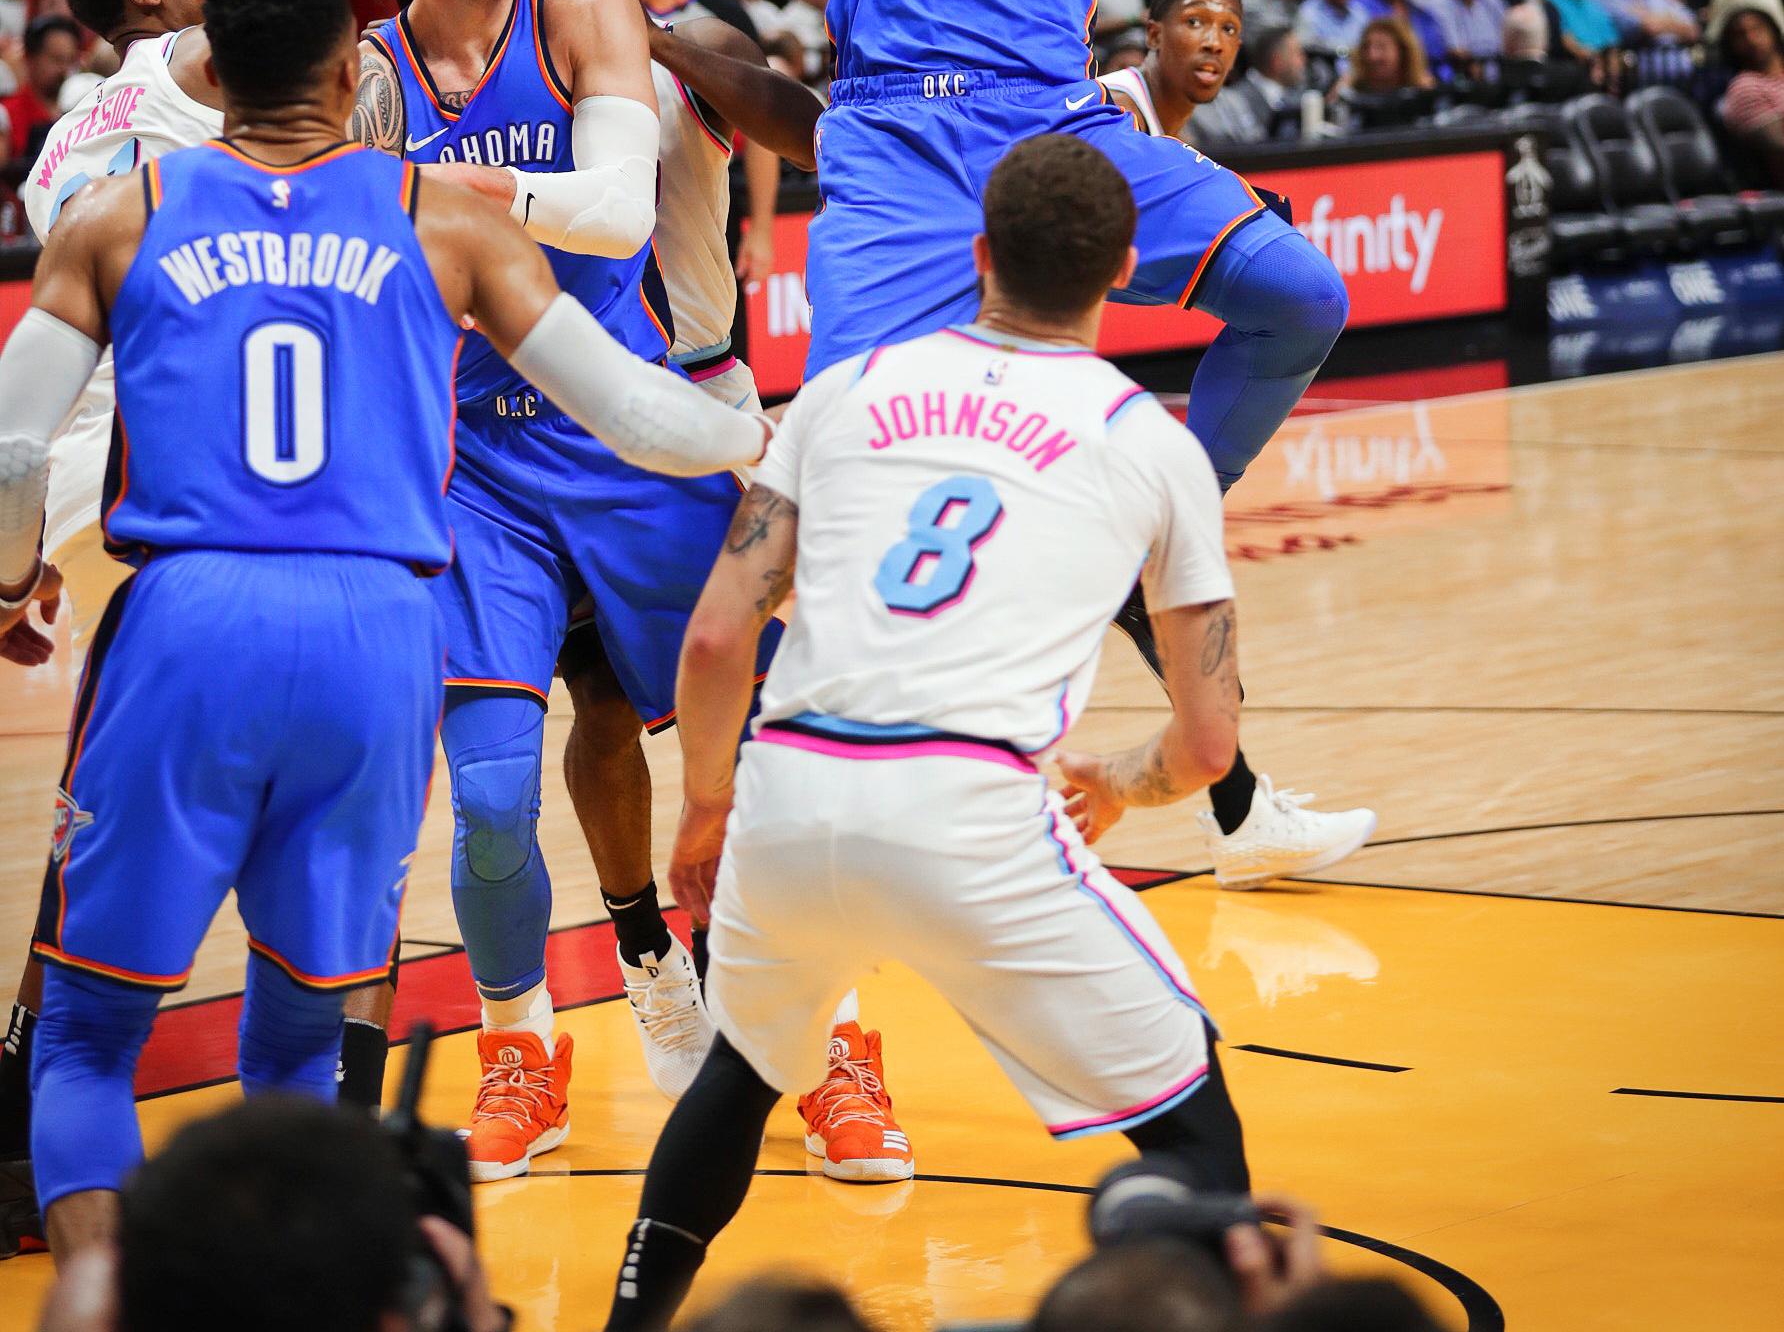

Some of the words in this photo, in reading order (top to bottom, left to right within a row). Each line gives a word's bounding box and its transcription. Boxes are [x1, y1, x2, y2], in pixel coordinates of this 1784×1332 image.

[923, 73, 967, 98] OKC
[36, 87, 146, 190] WHITESIDE
[158, 230, 402, 306] WESTBROOK
[242, 320, 330, 488] 0
[868, 390, 1079, 473] JOHNSON
[873, 475, 1007, 620] 8
